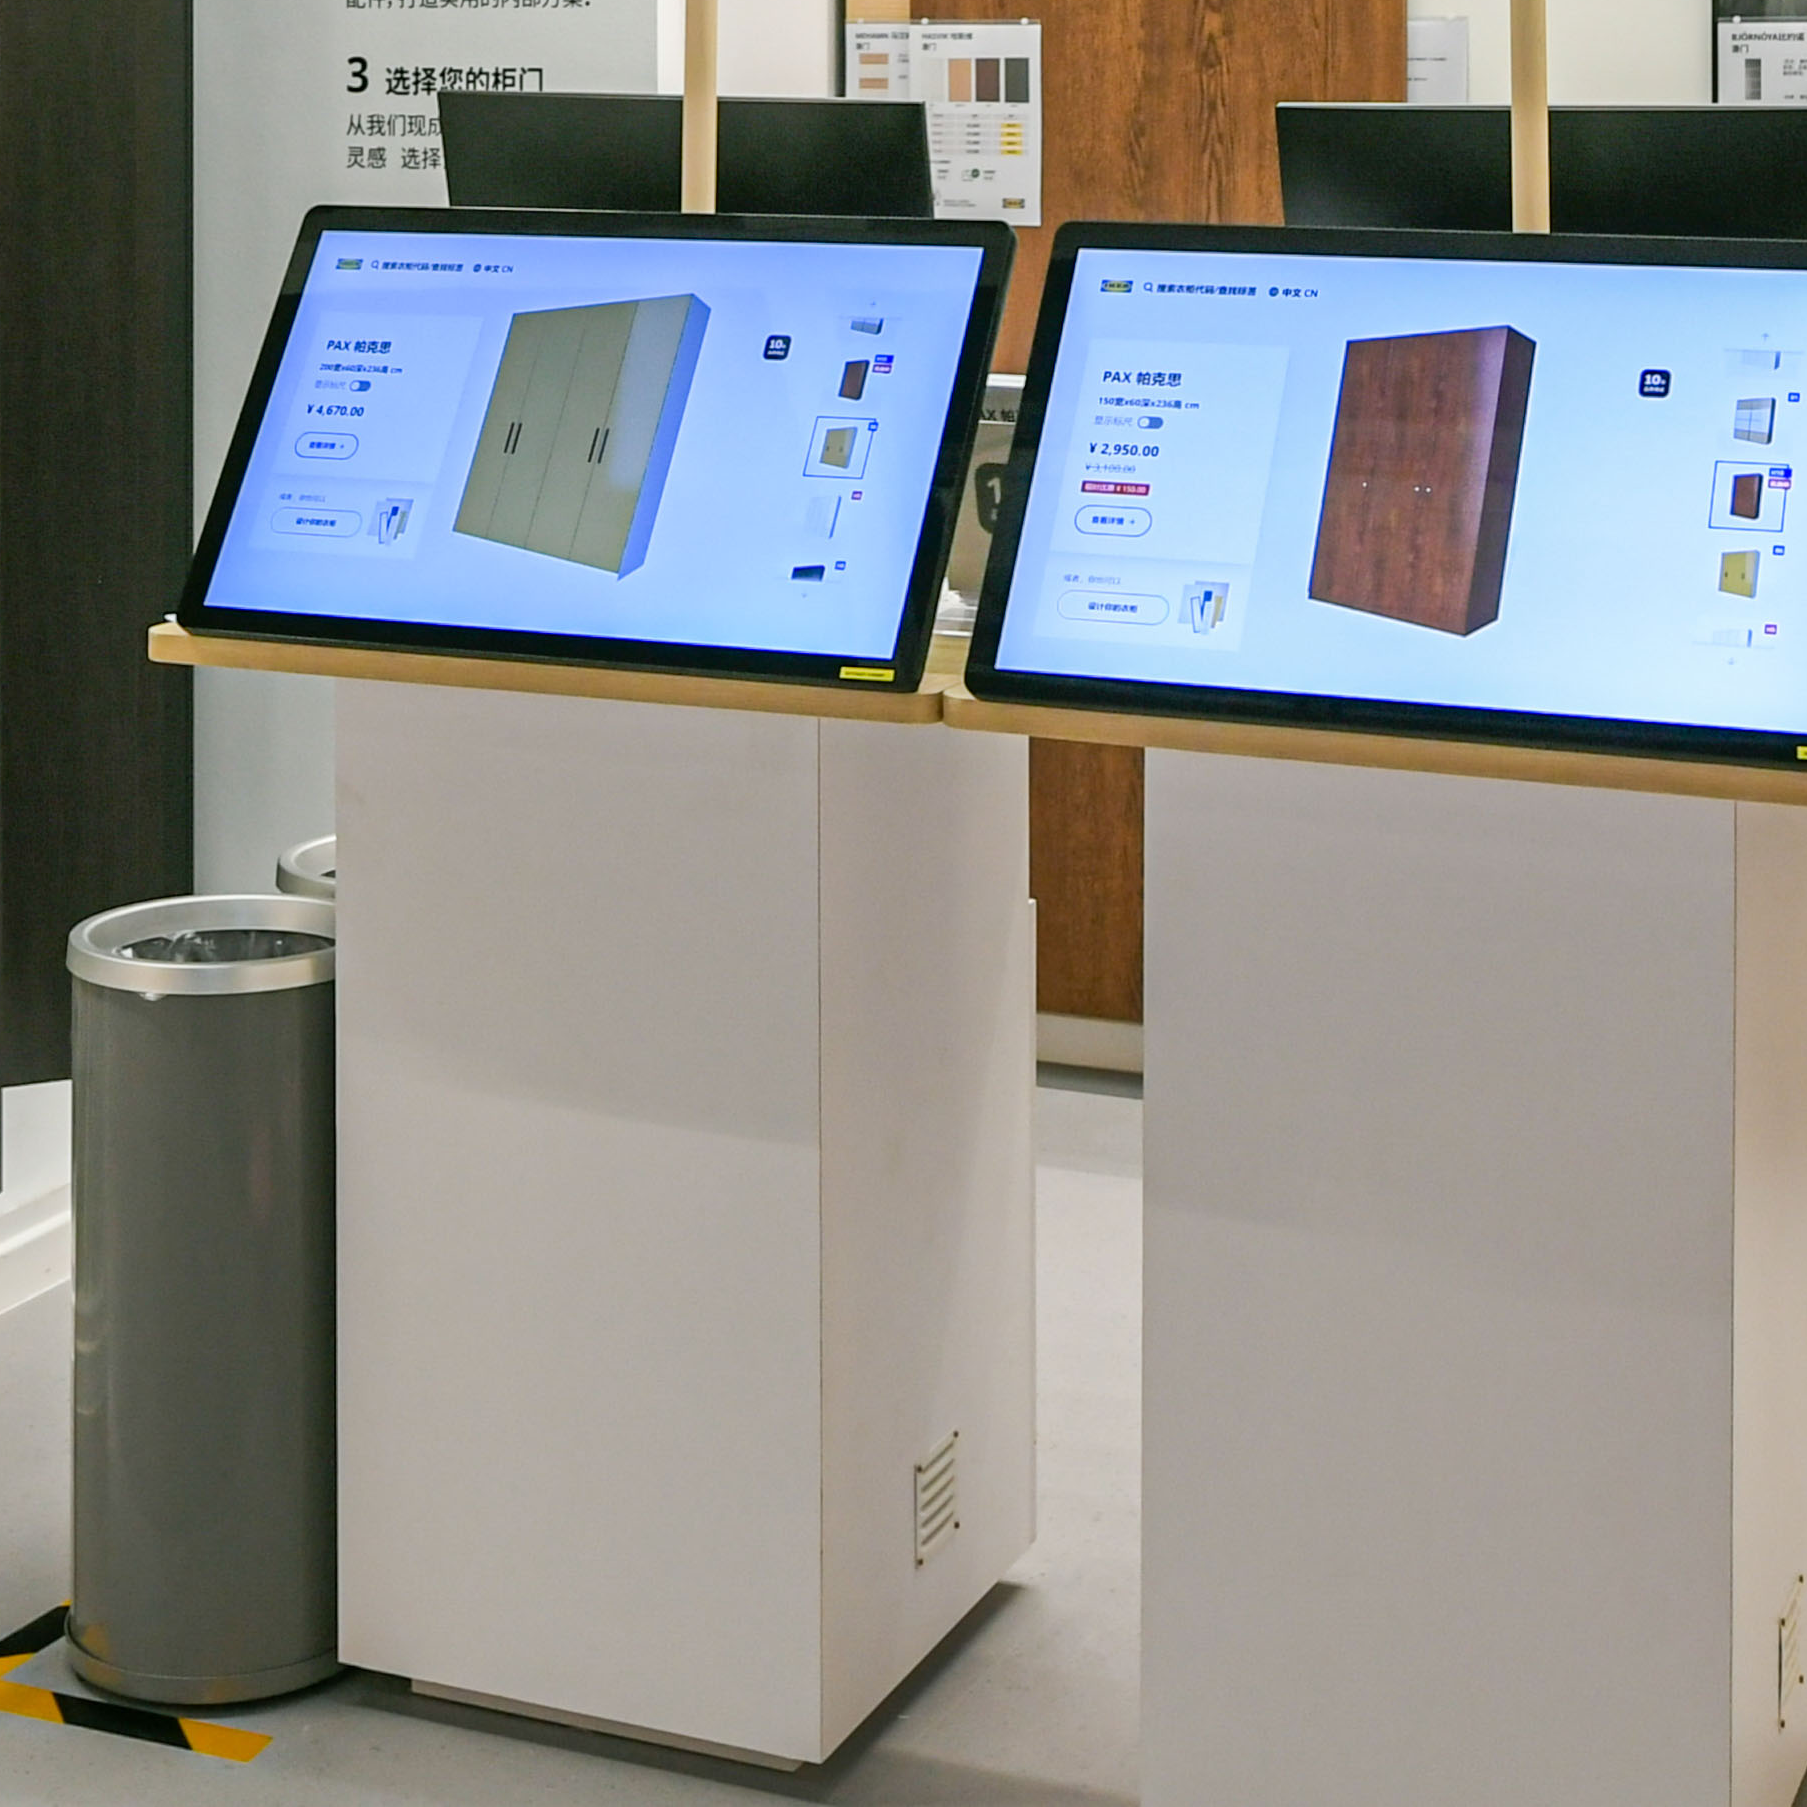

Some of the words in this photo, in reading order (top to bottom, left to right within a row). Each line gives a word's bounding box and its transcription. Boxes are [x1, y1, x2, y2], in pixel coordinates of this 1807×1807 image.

[346, 56, 369, 93] 3
[385, 66, 544, 96] 选择您的柜门
[326, 340, 351, 352] PAX
[1102, 370, 1133, 384] PAX
[1136, 371, 1182, 387] 帕克思
